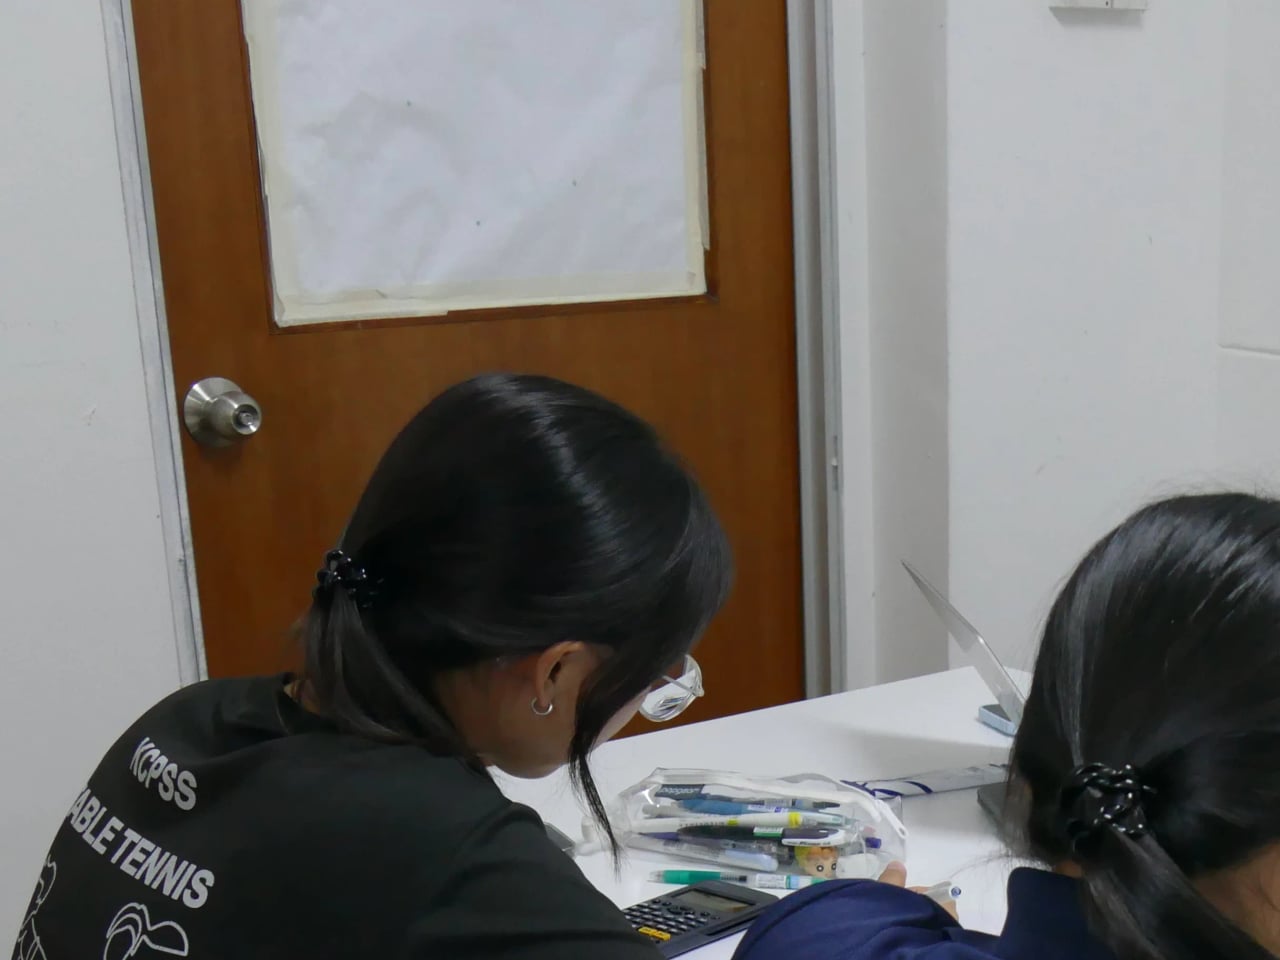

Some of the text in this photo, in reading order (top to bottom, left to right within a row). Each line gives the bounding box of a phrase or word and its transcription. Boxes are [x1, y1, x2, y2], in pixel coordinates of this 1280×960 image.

[129, 737, 198, 811] KCPSS
[69, 788, 215, 909] ABLE TENNIS
